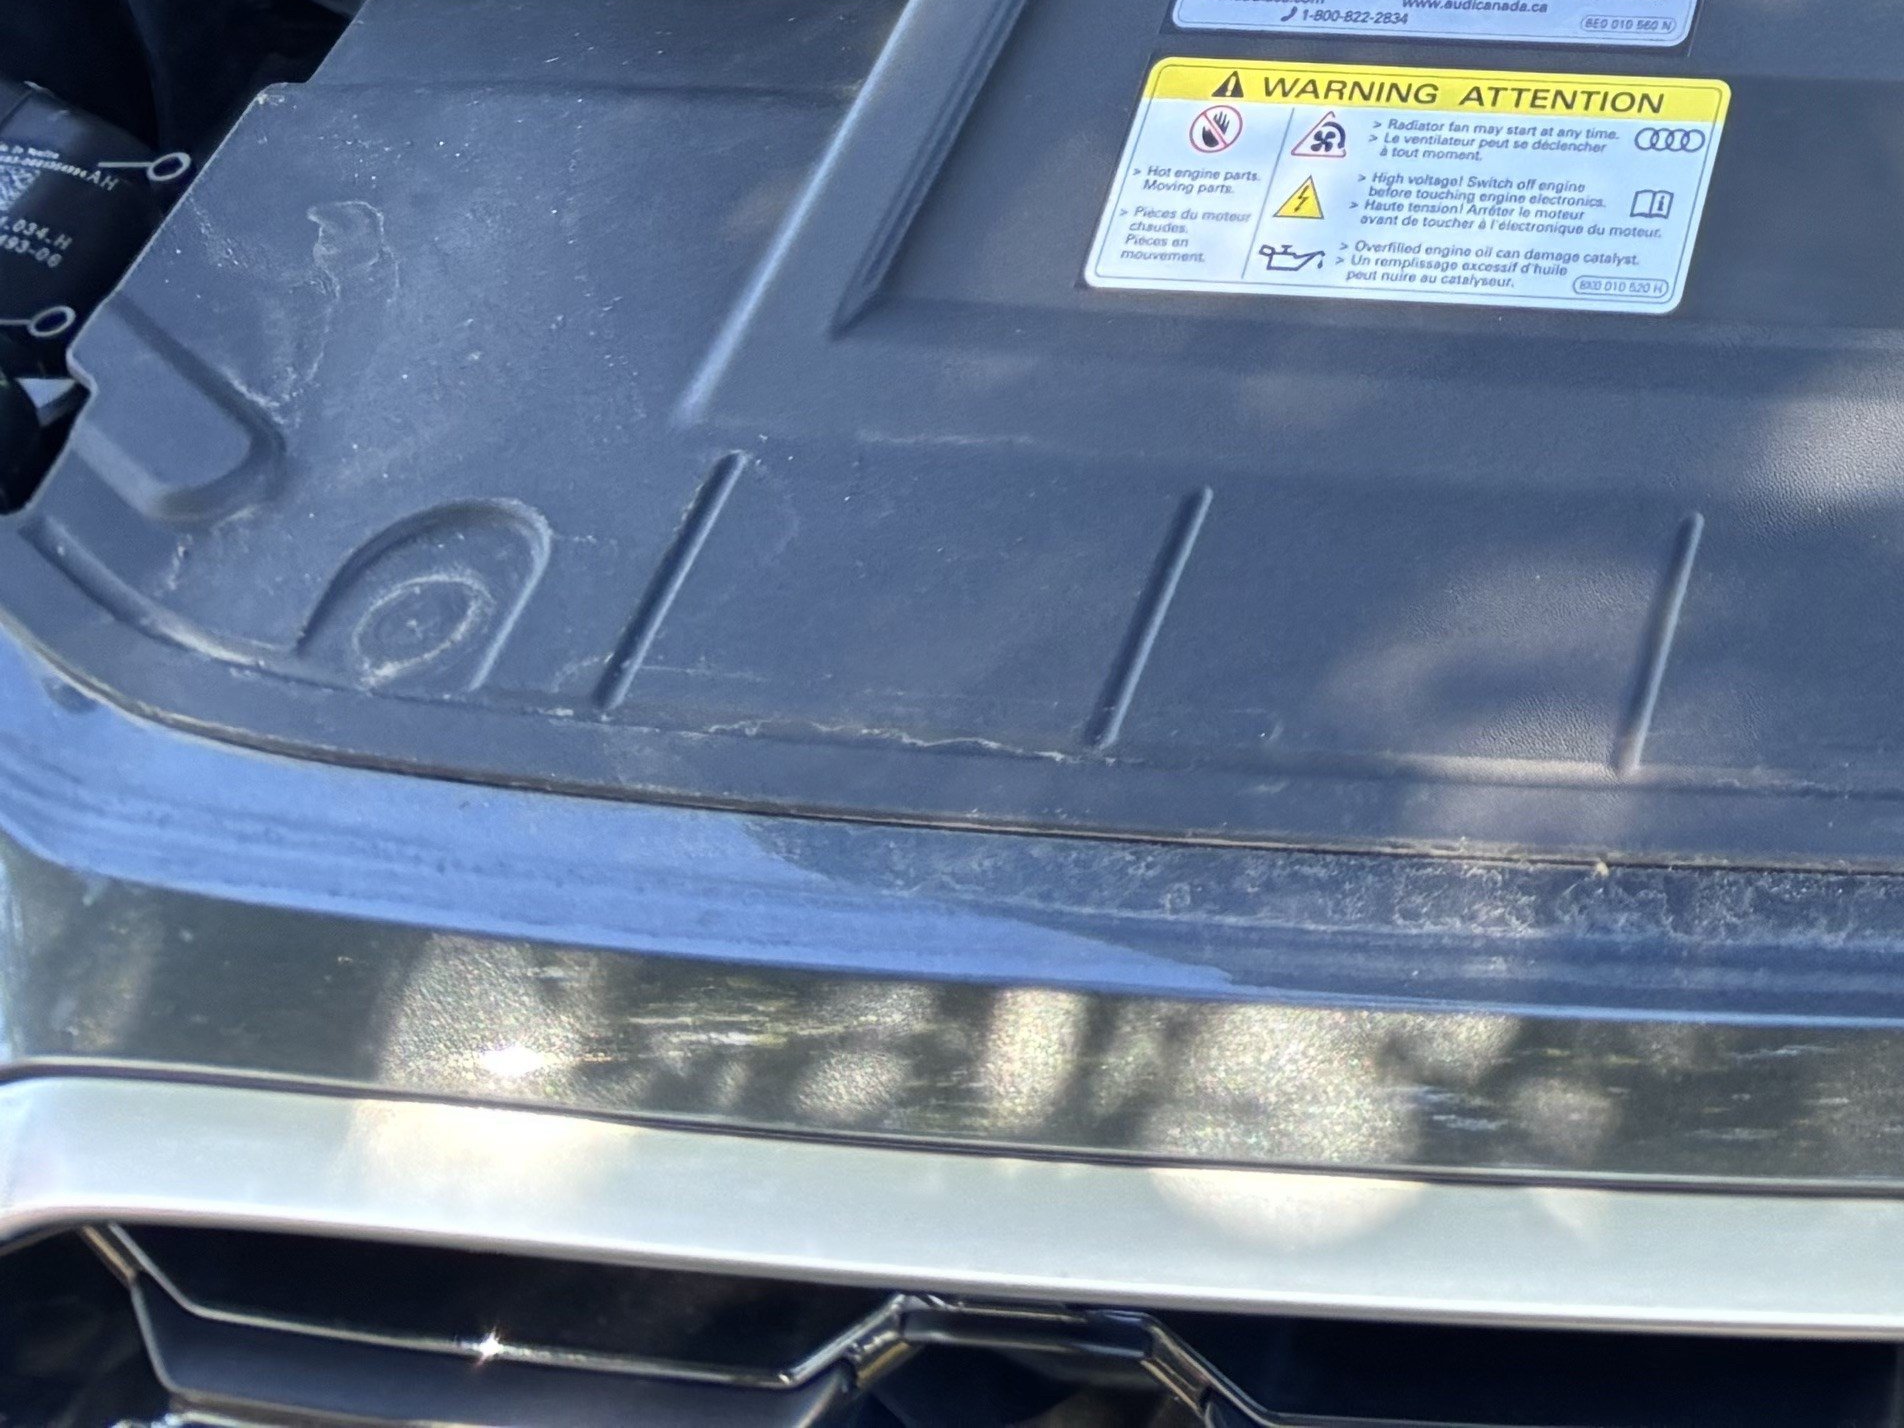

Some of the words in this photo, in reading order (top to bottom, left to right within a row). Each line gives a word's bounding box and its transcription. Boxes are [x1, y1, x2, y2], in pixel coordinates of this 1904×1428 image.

[1303, 9, 1407, 23] 1-800-822-2834
[1264, 77, 1437, 103] WARNING
[1460, 86, 1663, 112] ATTENTION
[1387, 118, 1444, 131] Radiator
[1448, 121, 1469, 132] fan
[1473, 125, 1503, 135] may
[1506, 126, 1537, 136] start
[1540, 127, 1553, 136] at
[1556, 128, 1581, 138] any
[1585, 127, 1619, 139] time.
[1383, 132, 1399, 143] Le
[1404, 136, 1475, 146] ventilateur
[1478, 139, 1509, 148] peut
[1512, 140, 1528, 149] se
[1391, 147, 1418, 158] tout
[1422, 150, 1481, 161] moment.
[1147, 165, 1171, 176] Hot
[1174, 169, 1220, 180] engine
[1223, 171, 1259, 181] parts.
[1143, 179, 1193, 194] Moving
[1197, 184, 1232, 194] parts.
[1371, 172, 1403, 186] High
[1467, 175, 1512, 188] Switch
[1516, 178, 1536, 189] off
[1538, 180, 1585, 193] engine
[1368, 185, 1411, 198] before
[1416, 189, 1475, 203] touching
[1479, 193, 1525, 204] engine
[1180, 208, 1197, 220] du
[1201, 211, 1251, 222] moteur
[1364, 199, 1404, 211] Haute
[1518, 206, 1530, 217] le
[1534, 209, 1584, 219] moteur
[1360, 215, 1397, 225] avant
[1401, 215, 1418, 226] de
[1422, 217, 1473, 228] toucher
[1587, 224, 1605, 235] du
[1609, 226, 1661, 237] moteur.
[1171, 238, 1188, 247] en
[1120, 250, 1204, 262] mouvement.
[1354, 240, 1421, 253] Overfilled
[1424, 244, 1471, 257] engine
[1474, 246, 1493, 257] oil
[1495, 249, 1520, 258] can
[1524, 248, 1579, 263] damage
[1583, 252, 1638, 266] catalyst.
[1350, 254, 1370, 265] Un
[1374, 258, 1457, 271] remplissage
[1461, 262, 1517, 272] excessif
[1345, 270, 1376, 280] peut
[1381, 272, 1416, 282] nuire
[1419, 274, 1436, 283] au
